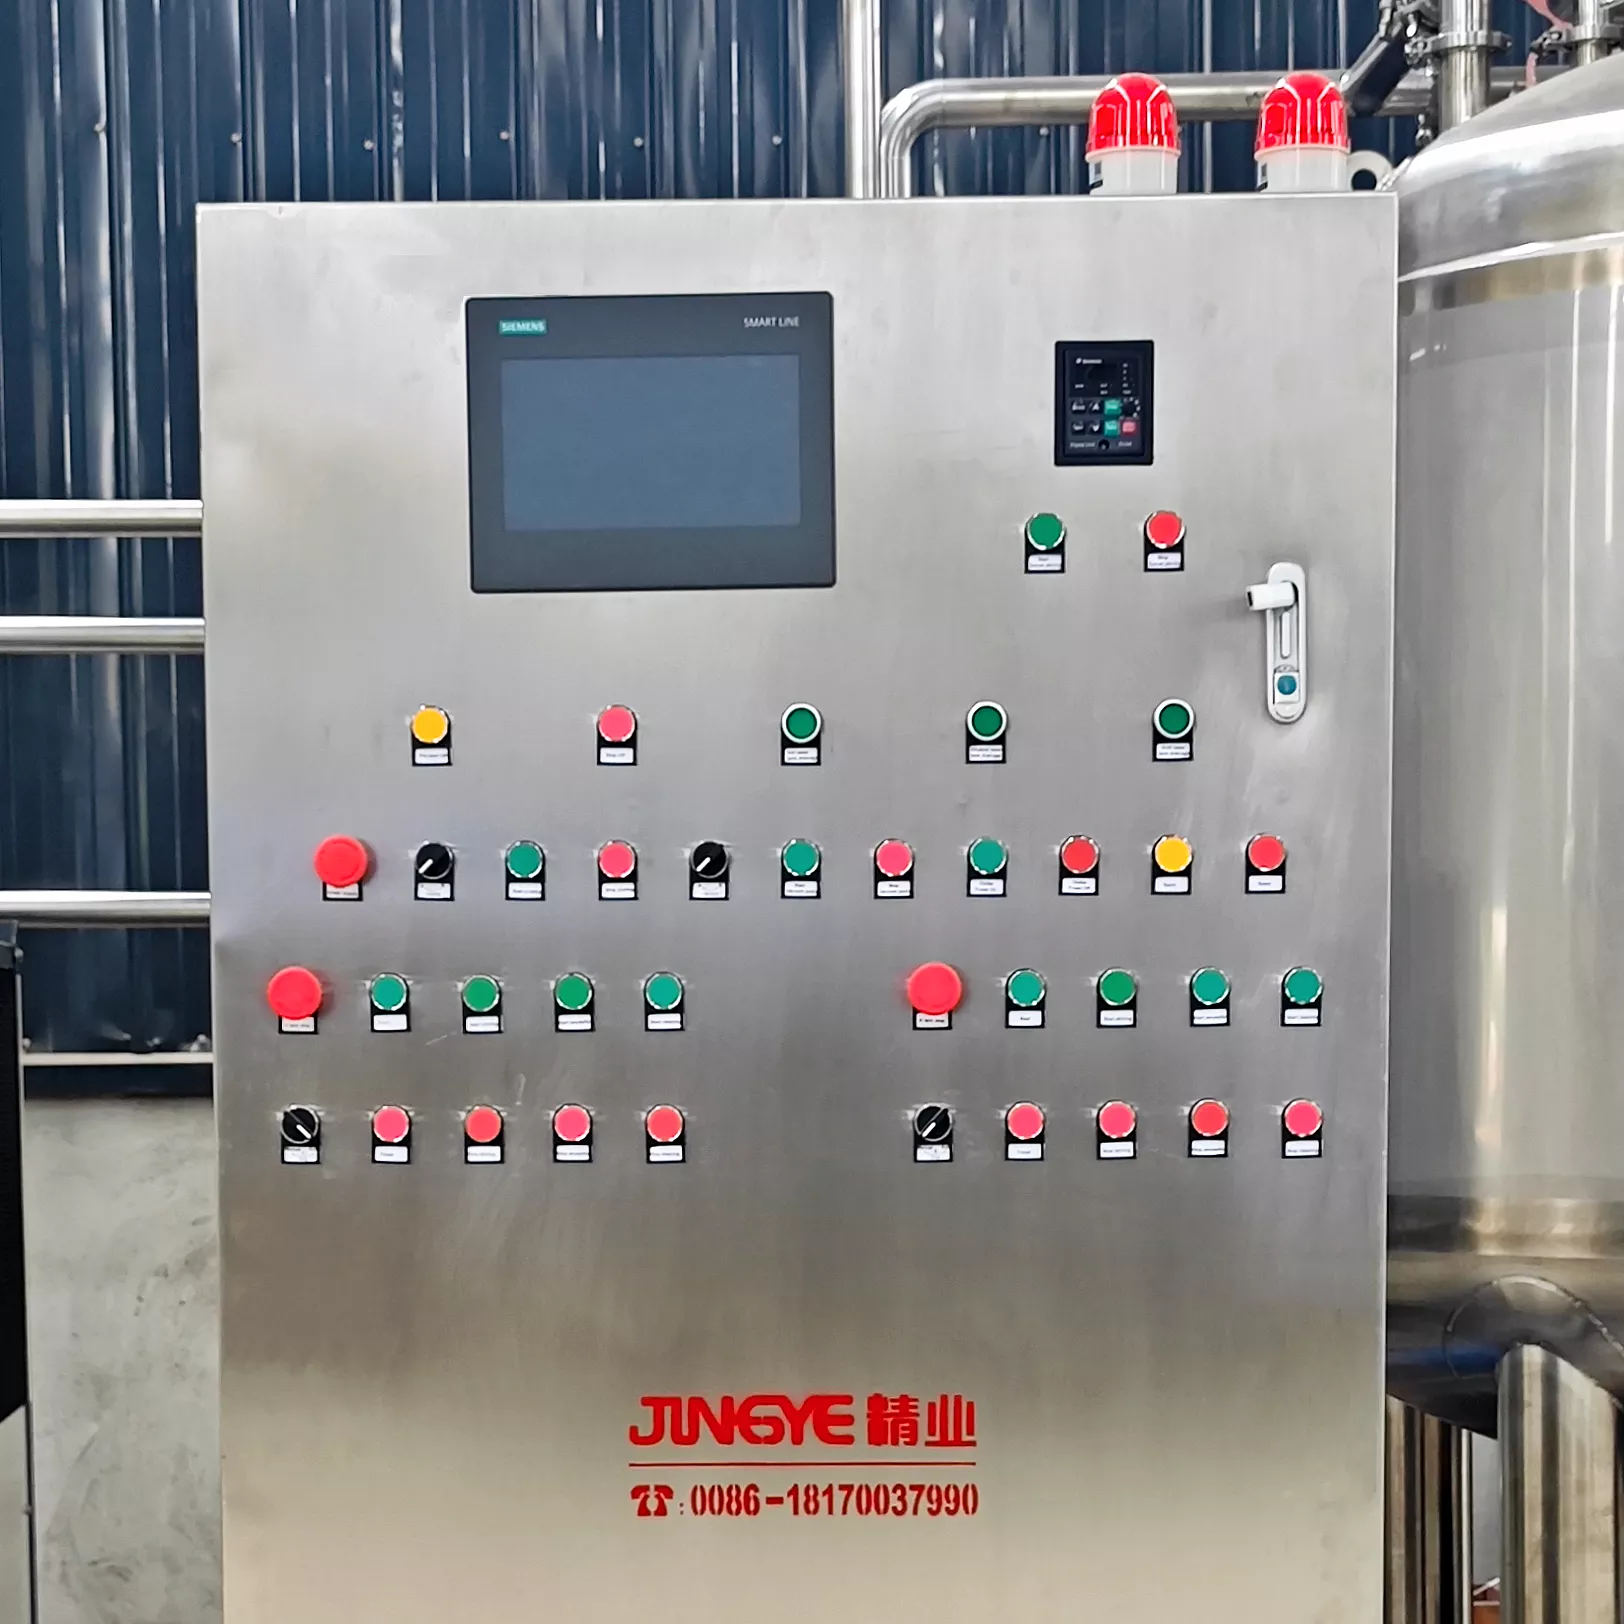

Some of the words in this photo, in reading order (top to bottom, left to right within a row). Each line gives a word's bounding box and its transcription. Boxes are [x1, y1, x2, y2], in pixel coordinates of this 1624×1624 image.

[500, 320, 546, 333] SIEMENS
[743, 316, 776, 329] SMART
[778, 315, 800, 328] LINE
[628, 1394, 855, 1445] JINGYE
[866, 1393, 977, 1447] 精业
